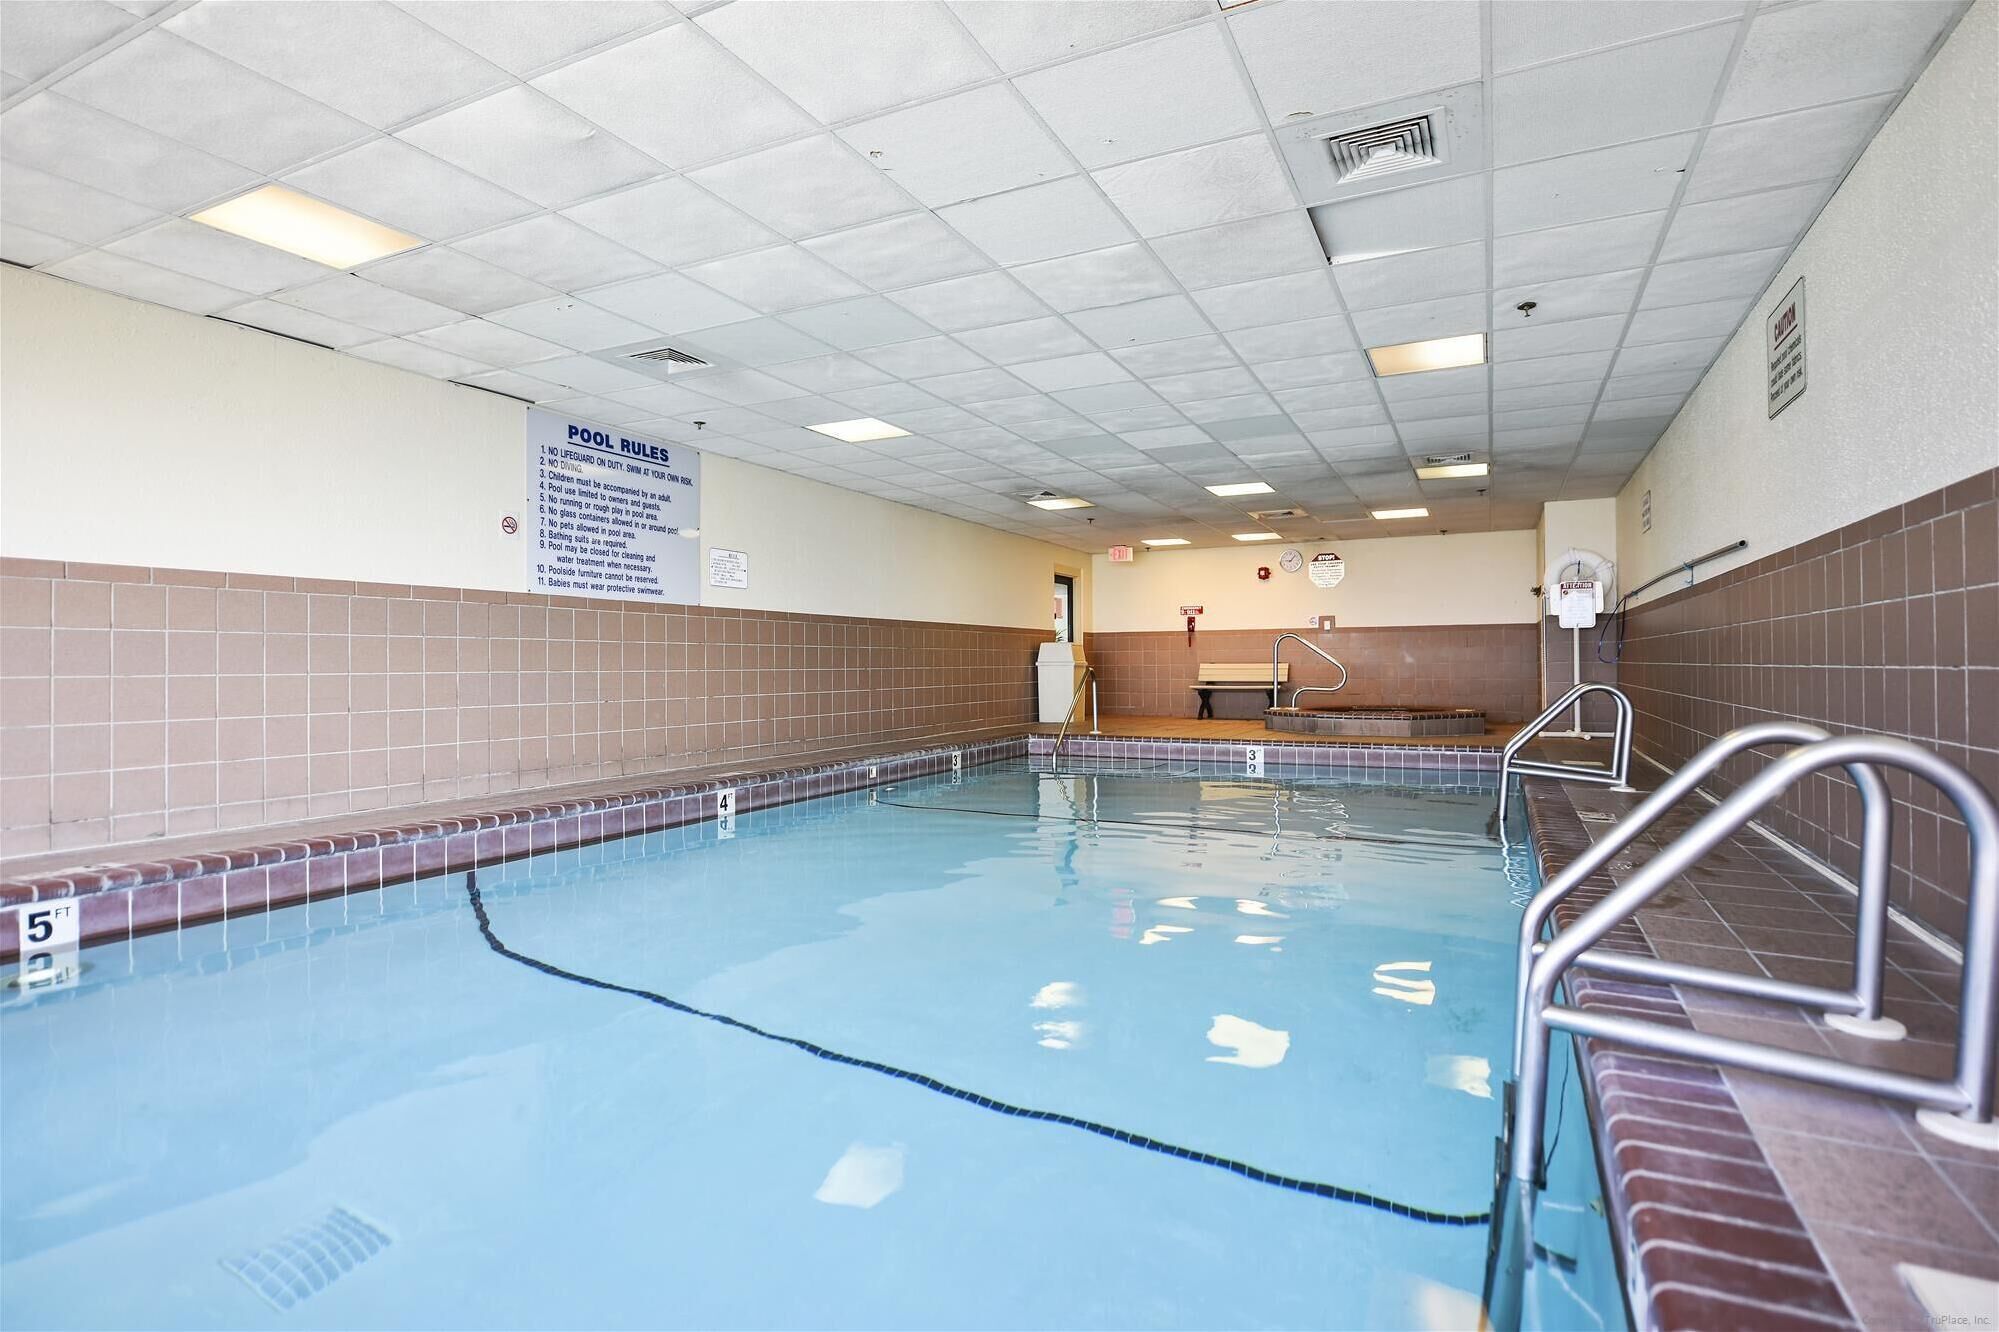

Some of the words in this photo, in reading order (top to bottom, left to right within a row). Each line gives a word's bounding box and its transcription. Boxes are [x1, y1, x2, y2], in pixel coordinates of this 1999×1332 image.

[1775, 302, 1796, 342] CAUTION
[568, 424, 614, 449] POOL
[620, 438, 669, 462] RULES
[540, 456, 546, 465] 2.
[548, 458, 558, 468] NO
[561, 460, 583, 473] DIVING.
[541, 445, 546, 454] 1.
[548, 446, 558, 456] NO
[561, 448, 594, 464] LIFEGUARD
[597, 457, 605, 467] ON
[608, 460, 624, 471] DUTY.
[627, 464, 641, 474] SWIM
[651, 470, 665, 480] YOUR
[667, 473, 679, 483] OWN
[681, 476, 693, 487] RISK.
[540, 469, 546, 478] 3.
[549, 470, 574, 483] Children
[576, 478, 591, 487] must
[594, 480, 601, 488] be
[603, 482, 639, 496] accompanied
[642, 489, 648, 499] by
[658, 494, 671, 503] adult.
[540, 481, 546, 490] 4.
[549, 482, 562, 493] Pool
[565, 487, 576, 495] use
[578, 488, 598, 500] limited
[600, 493, 606, 501] to
[609, 496, 628, 505] owners
[642, 502, 661, 511] guests.
[540, 493, 546, 502] 5.
[549, 494, 557, 504] No
[560, 498, 582, 510] running
[593, 504, 609, 514] rough
[612, 506, 623, 516] play
[632, 510, 644, 518] pool
[646, 513, 658, 521] area.
[540, 505, 546, 514] 6.
[549, 506, 557, 516] No
[560, 508, 576, 518] glass
[579, 513, 610, 524] containers
[612, 517, 632, 528] allowed
[635, 520, 639, 528] in
[649, 524, 666, 533] around
[540, 517, 546, 526] 7.
[549, 518, 557, 528] No
[560, 522, 574, 530] pets
[577, 523, 599, 534] allowed
[601, 526, 606, 534] in
[540, 529, 546, 538] 8.
[549, 530, 572, 543] Bathing
[575, 535, 589, 544] suits
[603, 540, 627, 549] required.
[540, 540, 546, 548] 9.
[549, 541, 562, 551] Pool
[565, 544, 577, 554] may
[580, 545, 587, 554] be
[590, 547, 609, 557] closed
[622, 551, 644, 562] cleaning
[1112, 548, 1128, 560] EXIT
[537, 564, 546, 574] 10.
[549, 565, 575, 576] Poolside
[578, 569, 602, 578] furniture
[605, 572, 623, 580] cannot
[635, 576, 658, 584] reserved.
[557, 555, 574, 564] water
[577, 557, 605, 567] treatment
[607, 560, 621, 568] when
[624, 564, 652, 574] necessary.
[538, 577, 546, 585] 11.
[549, 578, 570, 588] Babies
[573, 581, 588, 589] must
[607, 584, 635, 593] protective
[638, 587, 664, 596] swimwear.
[954, 755, 958, 766] 3
[1249, 750, 1256, 760] 3
[720, 795, 728, 811] 4
[28, 911, 52, 942] 5
[55, 907, 71, 918] FT
